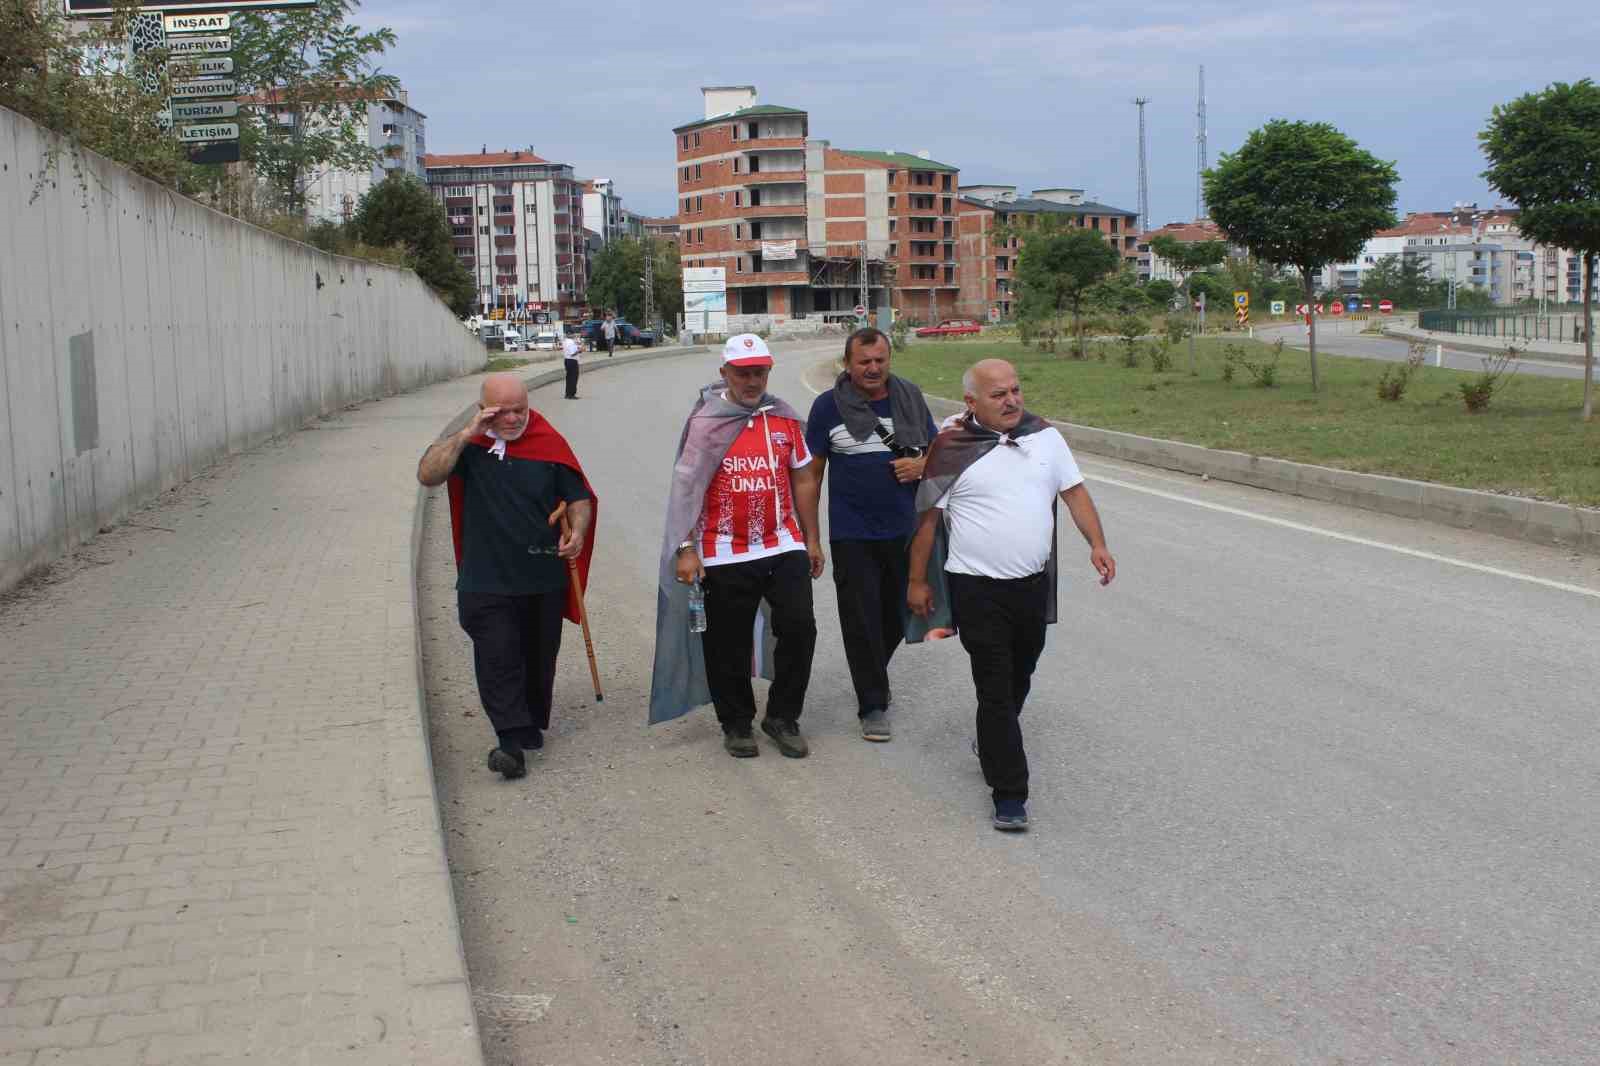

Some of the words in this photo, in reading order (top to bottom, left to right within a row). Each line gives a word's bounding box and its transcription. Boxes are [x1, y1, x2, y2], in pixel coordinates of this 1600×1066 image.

[173, 17, 224, 29] İNŞAAT
[170, 40, 229, 51] HAFRİYAT
[175, 104, 224, 116] TURİZM
[731, 475, 776, 493] ÜNAL
